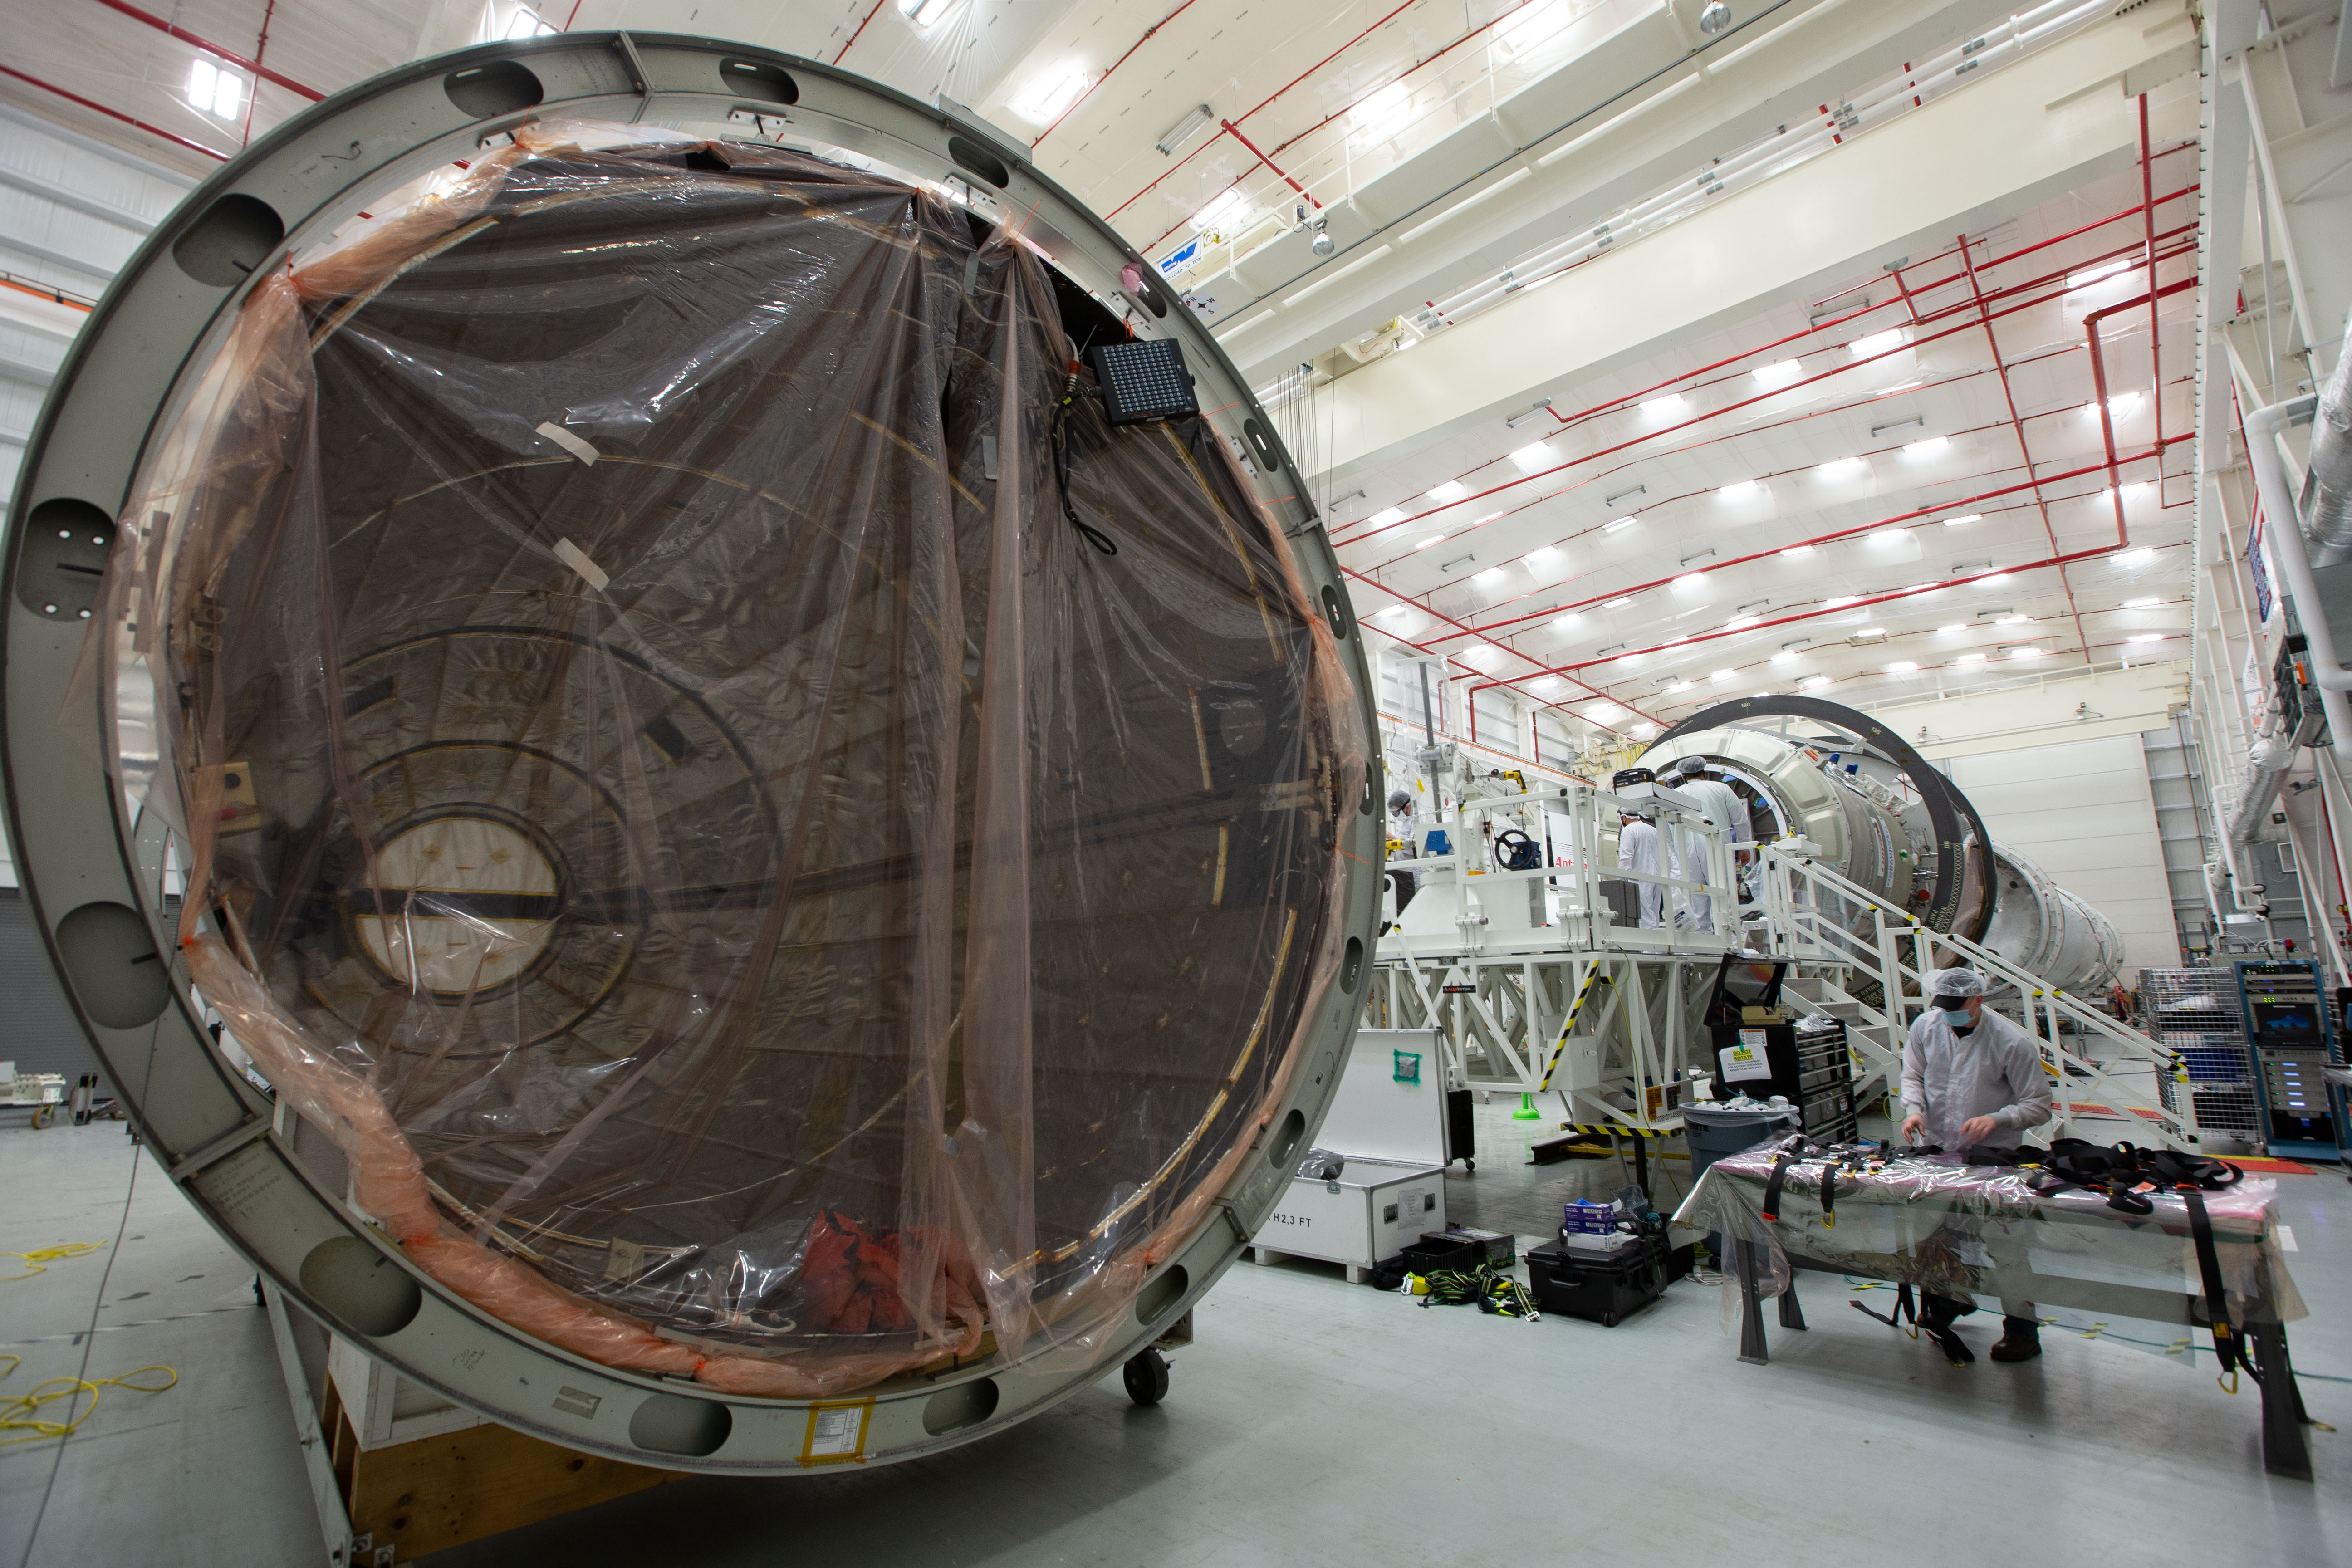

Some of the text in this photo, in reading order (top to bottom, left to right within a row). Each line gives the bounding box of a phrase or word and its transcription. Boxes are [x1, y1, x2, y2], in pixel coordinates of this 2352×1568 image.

[1171, 269, 1183, 278] LOAD
[1690, 1122, 1710, 1132] RUTE
[1299, 1217, 1311, 1227] FT
